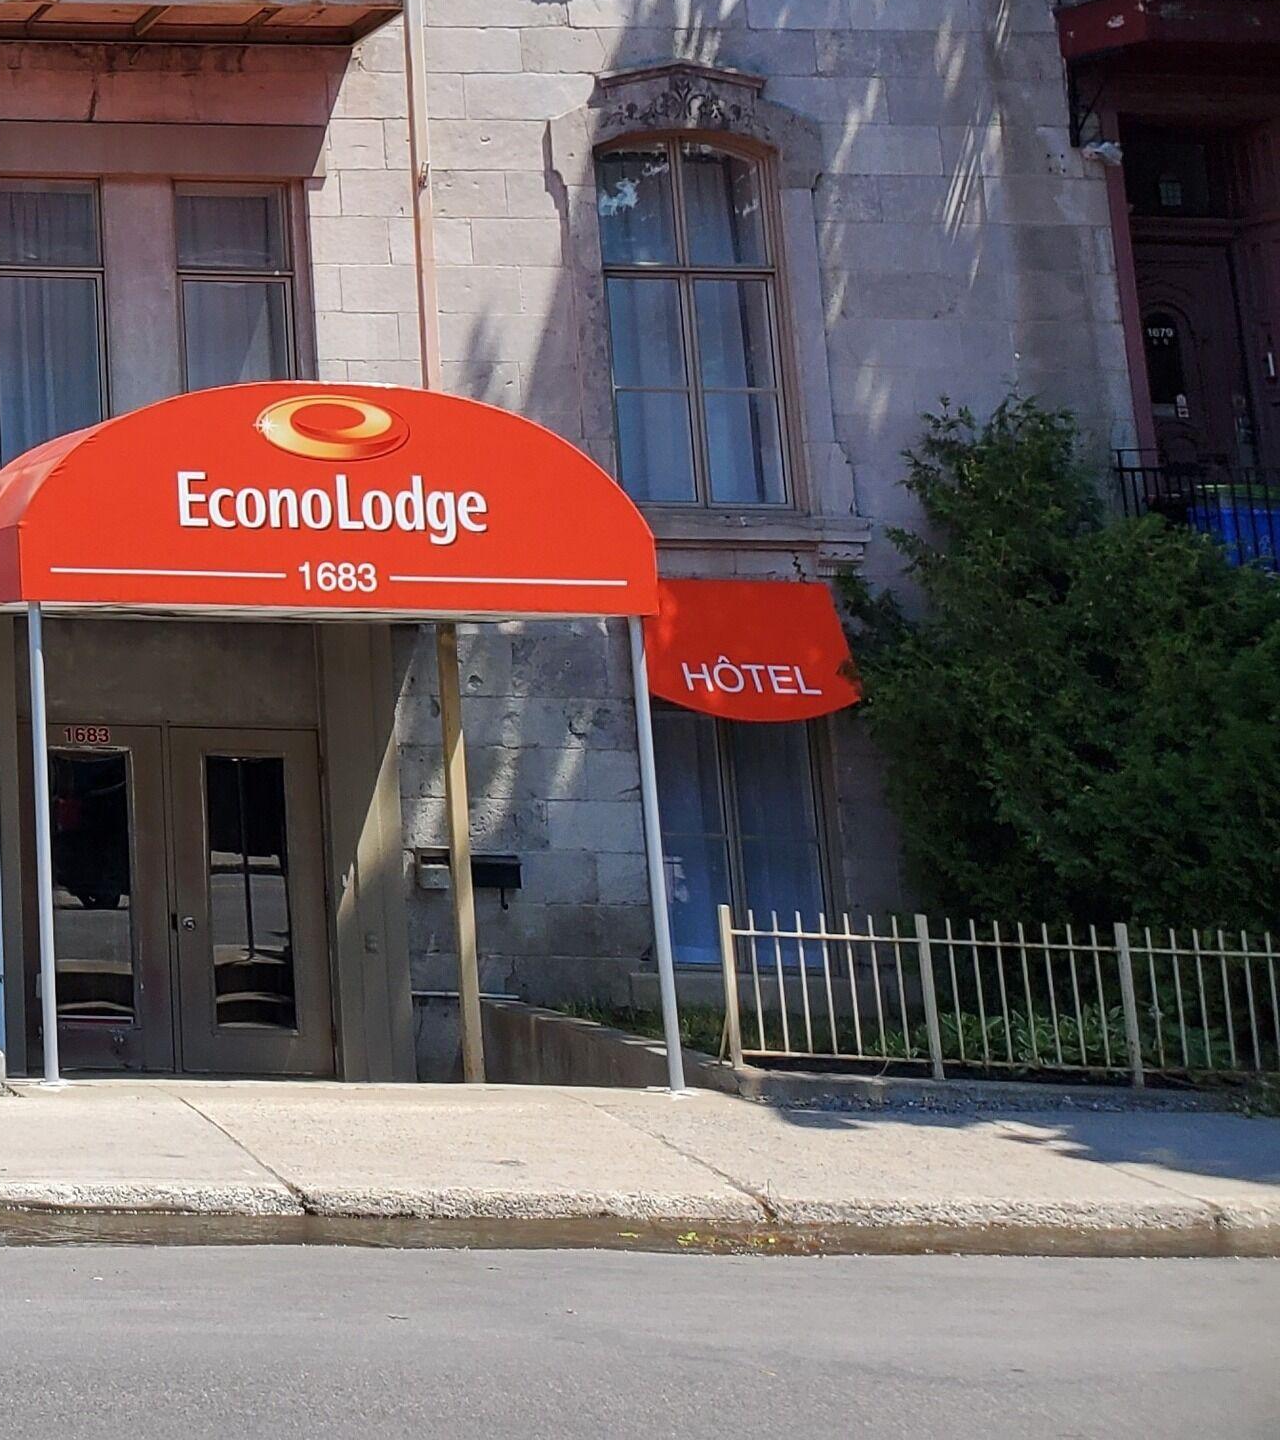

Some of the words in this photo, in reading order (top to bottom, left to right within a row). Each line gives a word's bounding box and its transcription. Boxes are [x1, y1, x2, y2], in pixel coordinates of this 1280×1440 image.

[177, 470, 488, 545] EconoLodge
[298, 561, 378, 592] 1683
[681, 655, 822, 695] HÔTEL
[64, 727, 110, 744] 1683
